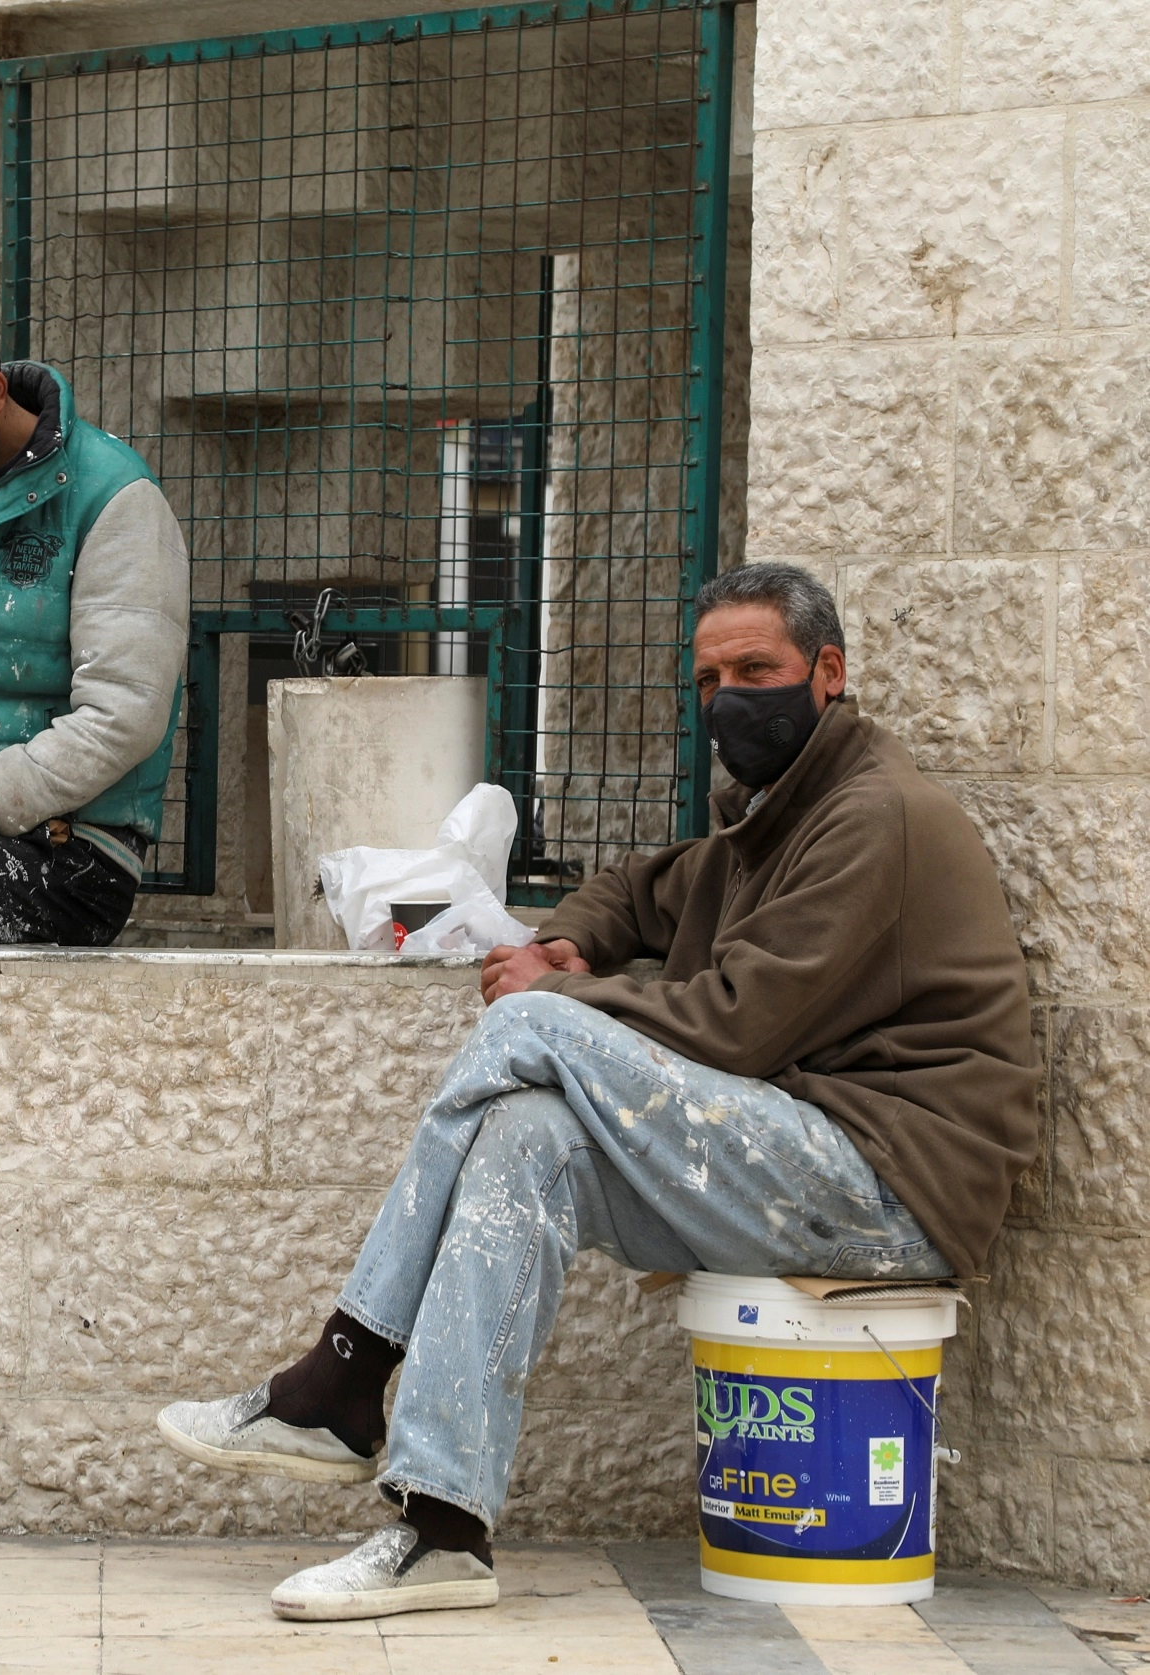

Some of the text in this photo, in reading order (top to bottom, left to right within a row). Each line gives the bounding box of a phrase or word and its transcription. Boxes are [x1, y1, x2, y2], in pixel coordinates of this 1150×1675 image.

[15, 544, 44, 556] NEVER
[22, 554, 33, 563] BE
[12, 561, 40, 573] TAMED
[736, 1422, 816, 1443] PAINTS
[826, 1493, 851, 1503] White
[703, 1498, 822, 1523] Interior Matt Emulsin
